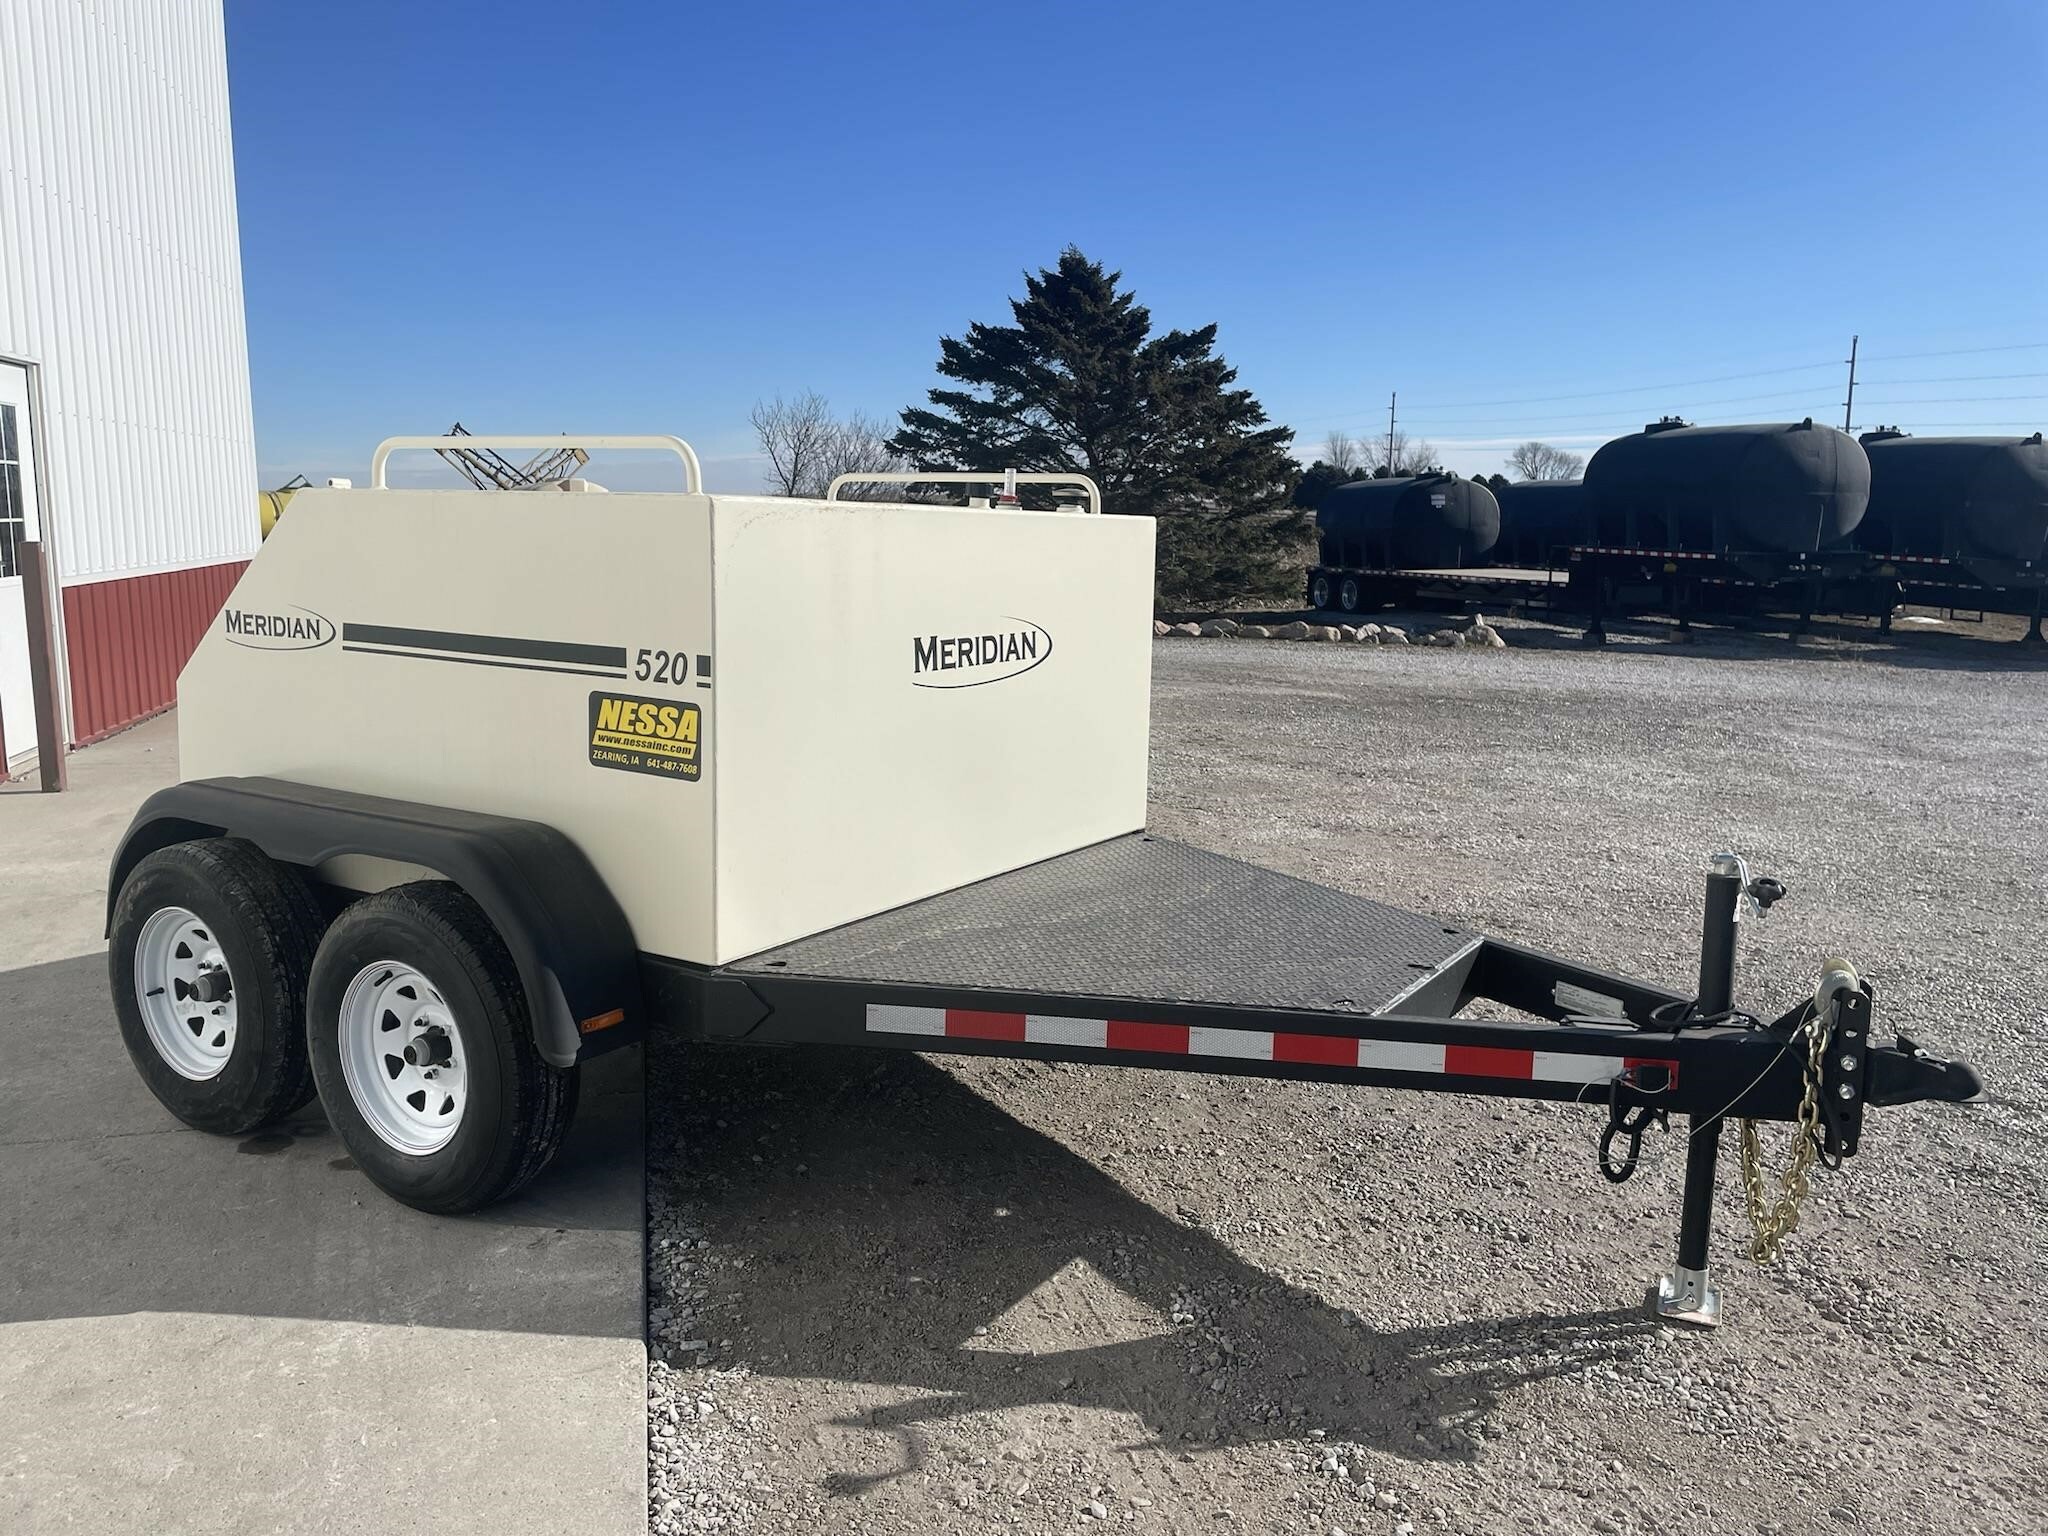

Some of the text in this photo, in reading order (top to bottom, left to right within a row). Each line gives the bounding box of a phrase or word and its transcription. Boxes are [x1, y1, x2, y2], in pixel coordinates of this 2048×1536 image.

[225, 610, 320, 640] MERIDIAN
[635, 649, 688, 685] 520
[913, 631, 1037, 673] MERIDIAN
[597, 699, 698, 742] NESSA
[598, 734, 691, 755] www.nessainc.com
[592, 750, 697, 774] ZEARING, IA 641-487-7608
